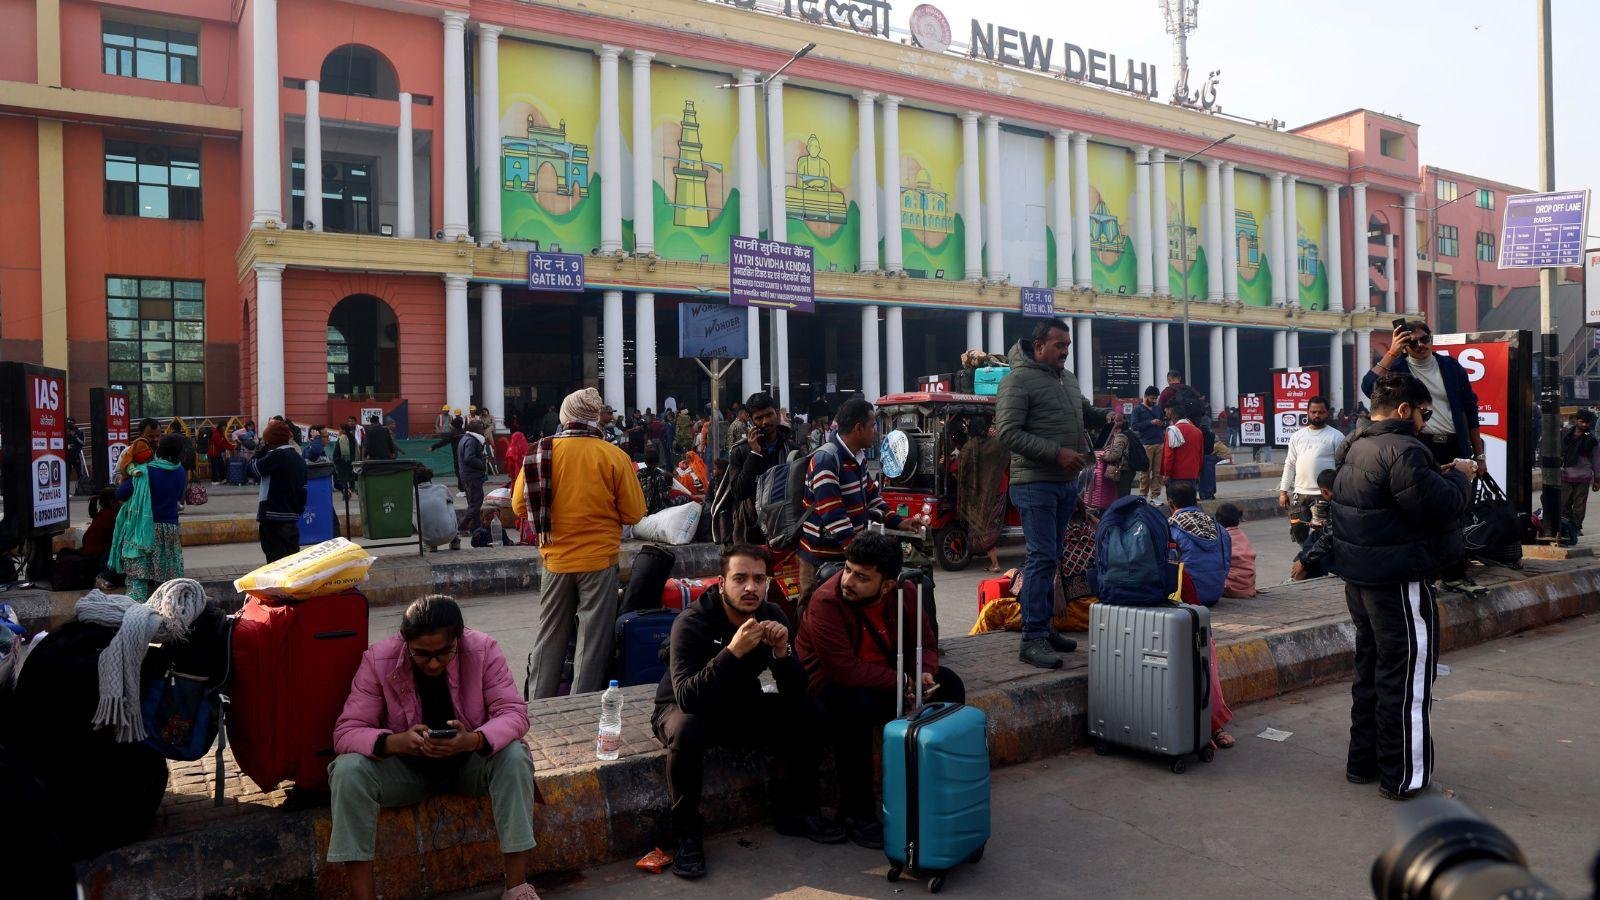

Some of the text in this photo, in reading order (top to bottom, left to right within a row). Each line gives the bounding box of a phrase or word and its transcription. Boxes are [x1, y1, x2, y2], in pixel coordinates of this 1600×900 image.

[971, 18, 1159, 99] NEW DELHI
[1535, 202, 1581, 214] DROP OFF LANE
[733, 239, 759, 251] यात्री
[760, 242, 792, 256] सुविधा
[533, 255, 553, 270] गेट
[571, 261, 579, 272] 9
[733, 253, 811, 273] YATRI SUVIDHA KENDRA
[532, 272, 581, 286] GATE NO. 9
[1025, 290, 1034, 302] गेट
[1044, 294, 1052, 303] 10
[1025, 303, 1038, 312] GATE
[704, 316, 741, 338] WONDER
[1281, 373, 1312, 389] IAS
[34, 378, 59, 411] IAS
[1243, 397, 1260, 408] IAS
[110, 397, 125, 417] IAS
[53, 489, 61, 499] IAS
